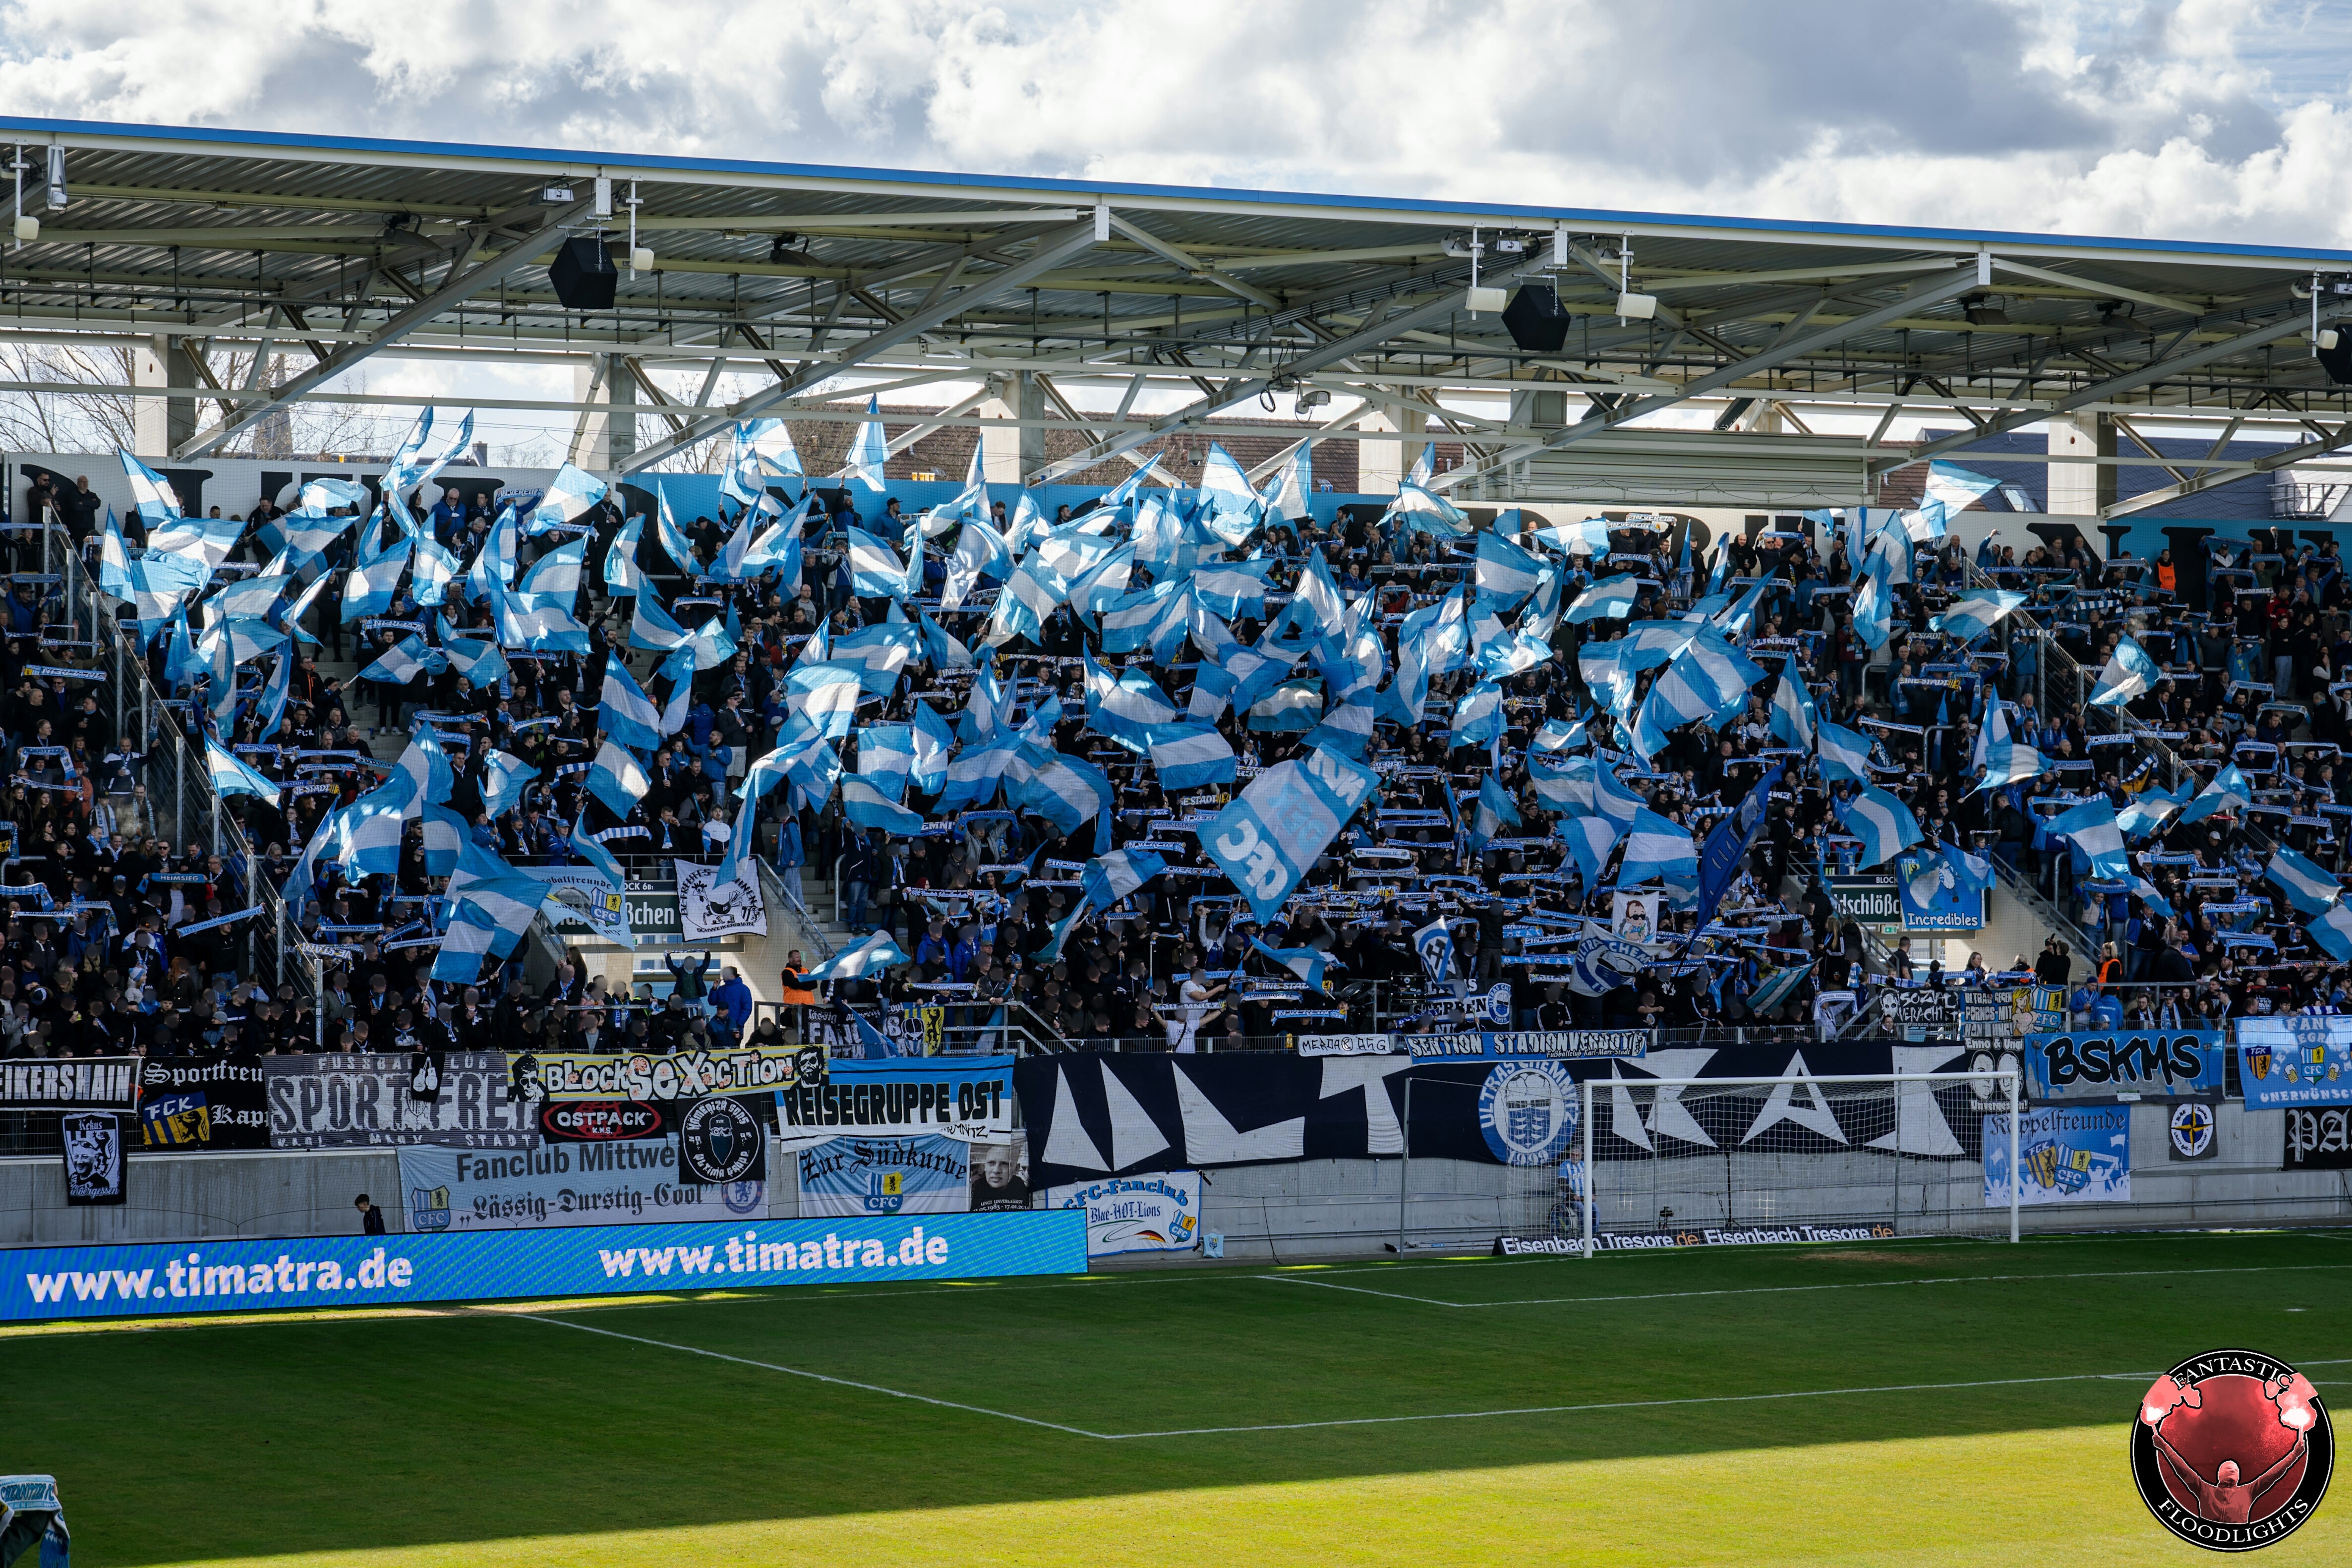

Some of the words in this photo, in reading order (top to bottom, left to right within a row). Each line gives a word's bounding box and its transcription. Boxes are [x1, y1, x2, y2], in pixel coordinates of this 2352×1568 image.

[2098, 734, 2131, 743] VEREIN
[593, 908, 617, 922] CFC
[1907, 912, 1979, 932] Incredibles
[696, 920, 756, 933] SCHWEIKERSHAIN
[1577, 937, 1604, 964] ULTRA
[1608, 941, 1651, 964] CHEM
[1994, 991, 2012, 1002] GEGEN
[1414, 997, 1486, 1016] STEREN
[1998, 1005, 2013, 1021] MIT
[2035, 1012, 2058, 1025] CFC
[1965, 1038, 1992, 1049] Enno
[1546, 1048, 1582, 1058] Fußballclub
[2043, 1035, 2202, 1087] BSKMS
[450, 1055, 487, 1069] LUB
[2304, 1065, 2322, 1075] CFC
[782, 1082, 951, 1126] REISEGRUPPE
[958, 1079, 1004, 1121] OST
[1480, 1061, 1515, 1129] ULTRAS
[1519, 1060, 1579, 1125] CHEMNITZ
[2259, 1087, 2352, 1103] UNERWÜNSC
[145, 1097, 193, 1119] FCK
[78, 1119, 103, 1131] Kekus
[557, 1111, 647, 1128] OSTPACK
[1990, 1108, 2126, 1139] Kppelfreunde
[2286, 1108, 2352, 1163] PA
[1508, 1148, 1549, 1165] 1999
[2028, 1141, 2051, 1156] FCK
[456, 1143, 570, 1182] Fanclub
[580, 1142, 679, 1172] Mittwe
[850, 1140, 967, 1180] Südkurve
[2058, 1169, 2082, 1185] CFC
[1063, 1179, 1189, 1209] CFC-Fanclub
[869, 1197, 898, 1209] CFC
[418, 1213, 445, 1225] CFC
[1171, 1225, 1188, 1238] CFC
[1601, 1231, 1674, 1249] Tresore
[1704, 1225, 1800, 1245] Eisenbach
[1800, 1224, 1870, 1242] Tresore
[598, 1226, 948, 1278] www.timatra.de
[26, 1246, 412, 1303] www.timatra.de
